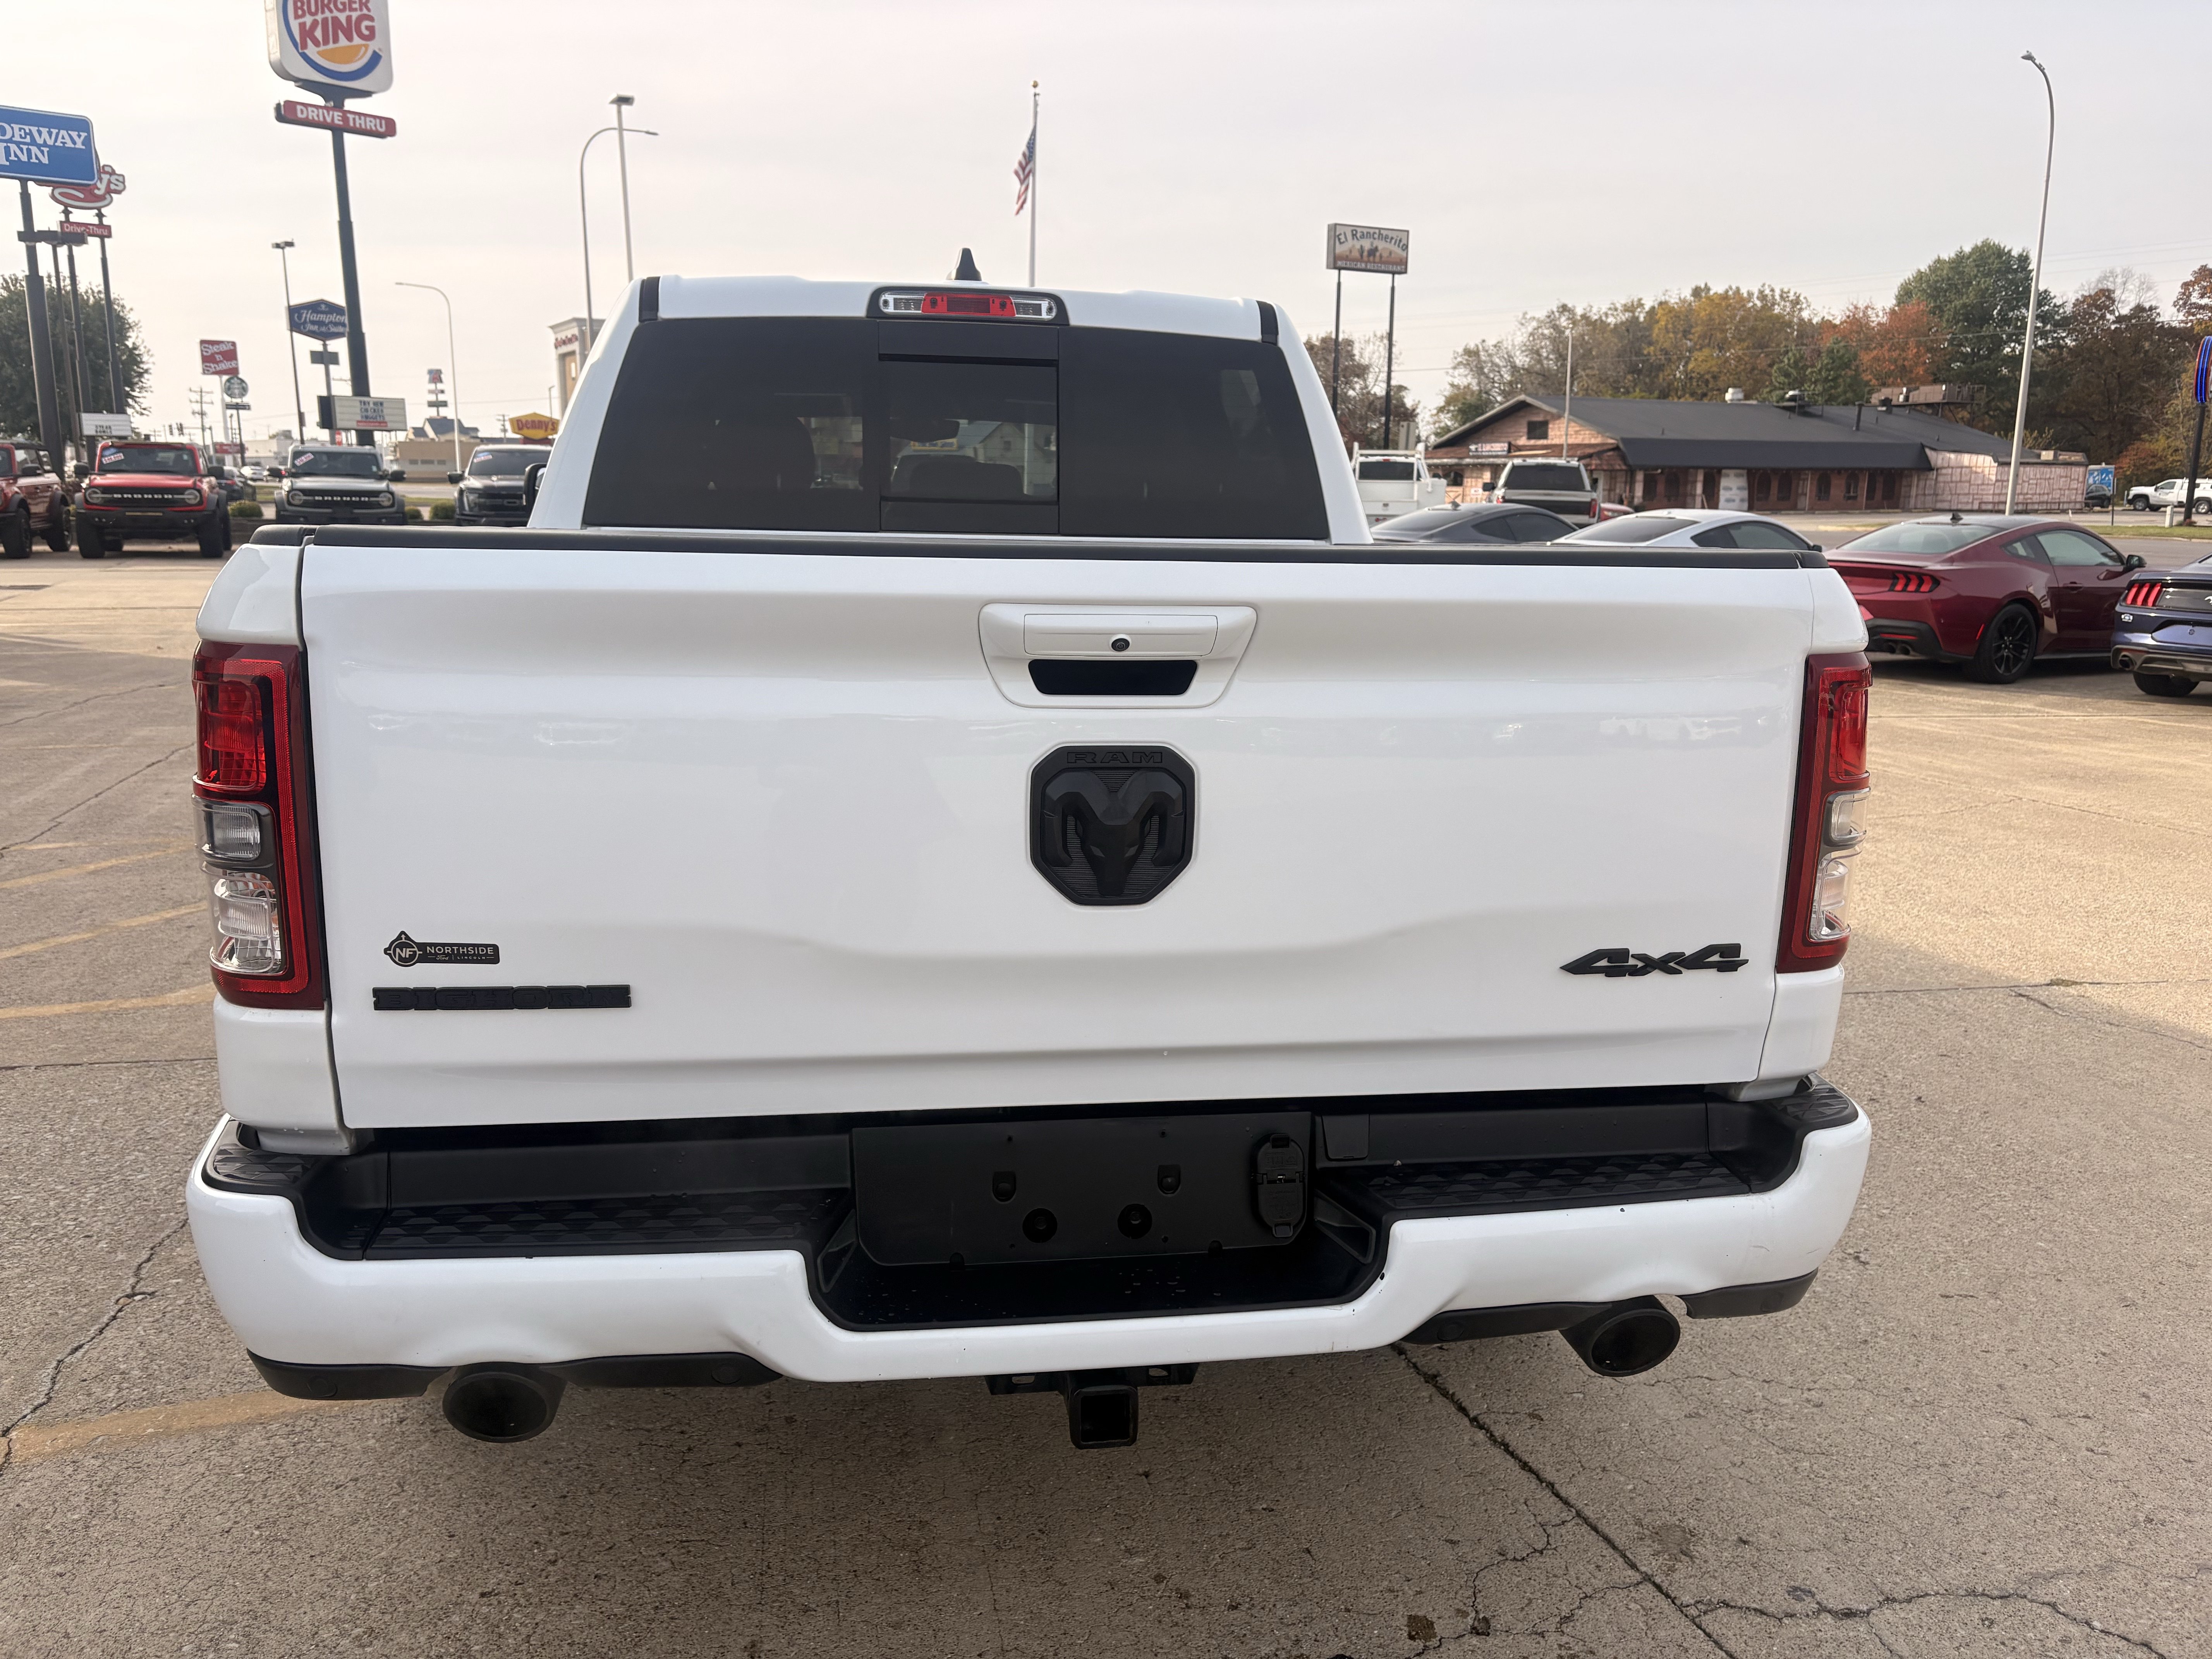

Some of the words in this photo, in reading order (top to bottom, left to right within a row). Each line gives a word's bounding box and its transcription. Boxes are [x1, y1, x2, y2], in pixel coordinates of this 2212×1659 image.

[293, 0, 371, 20] BURGER
[299, 14, 375, 51] KING
[297, 105, 343, 125] DRIVE
[347, 114, 386, 132] THRU
[1336, 232, 1348, 244] El
[1351, 228, 1408, 252] Rancherito
[201, 342, 234, 356] Steak
[203, 360, 237, 374] Shake
[516, 419, 556, 432] Denny's
[1067, 751, 1163, 764] RAM
[427, 946, 494, 954] NORTHSIDE
